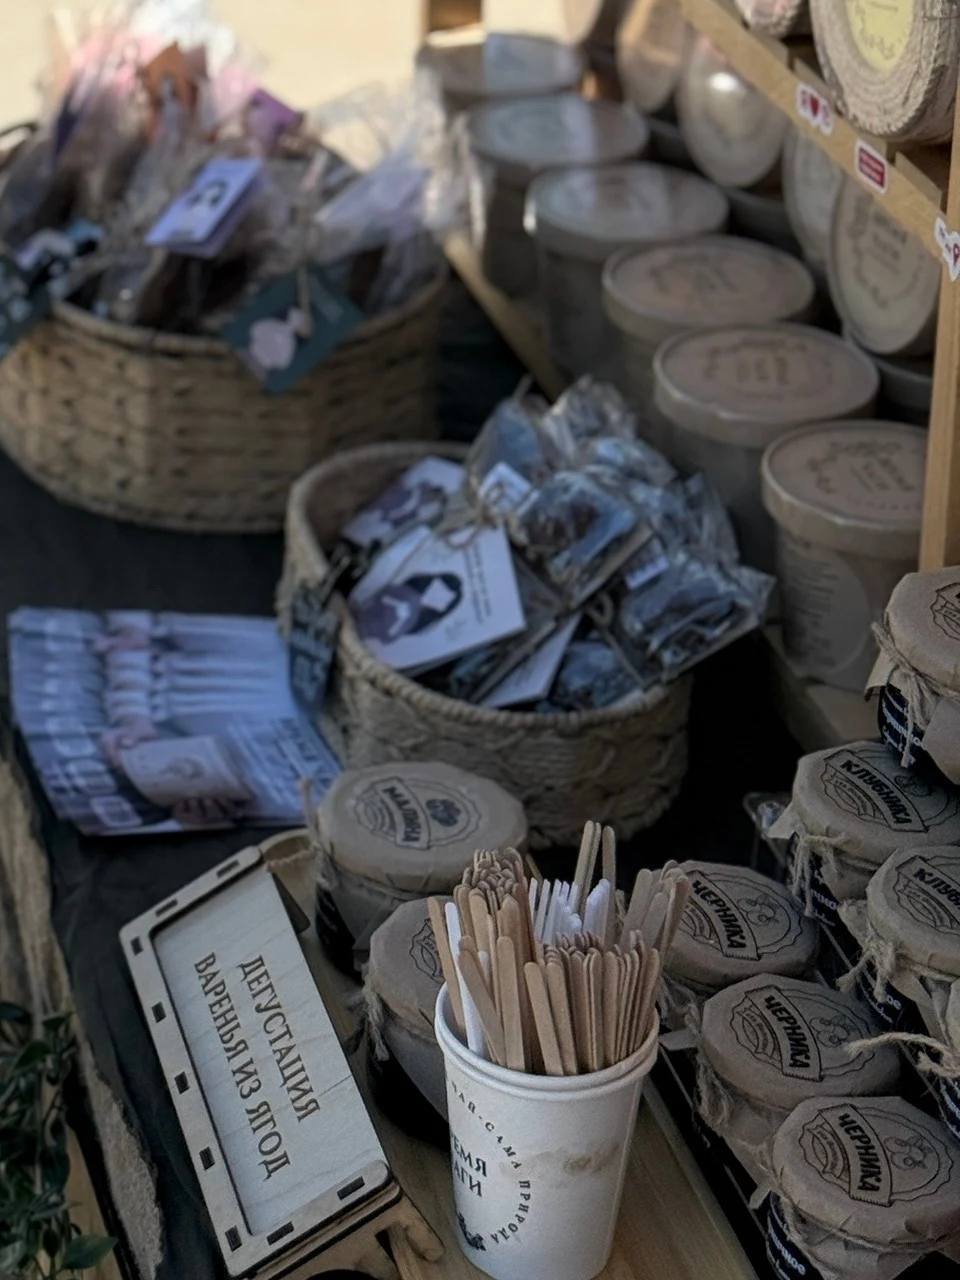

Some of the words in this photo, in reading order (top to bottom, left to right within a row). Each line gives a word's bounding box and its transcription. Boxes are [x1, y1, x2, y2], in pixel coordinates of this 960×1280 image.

[381, 786, 422, 843] МАЛИНА
[840, 758, 913, 825] КЛУБНИКА
[692, 879, 747, 949] ЧЕРНИКА
[193, 951, 249, 1064] ВАРЕНЬЯ
[236, 954, 321, 1123] ДЕГУСТАЦИЯ
[764, 994, 811, 1069] ЧЕРНИКА
[232, 1056, 262, 1101] ИЗ
[245, 1100, 291, 1181] ЯГОД
[838, 1112, 882, 1192] ЧЕРНИКА
[490, 1178, 532, 1245] ПРИРОДА
